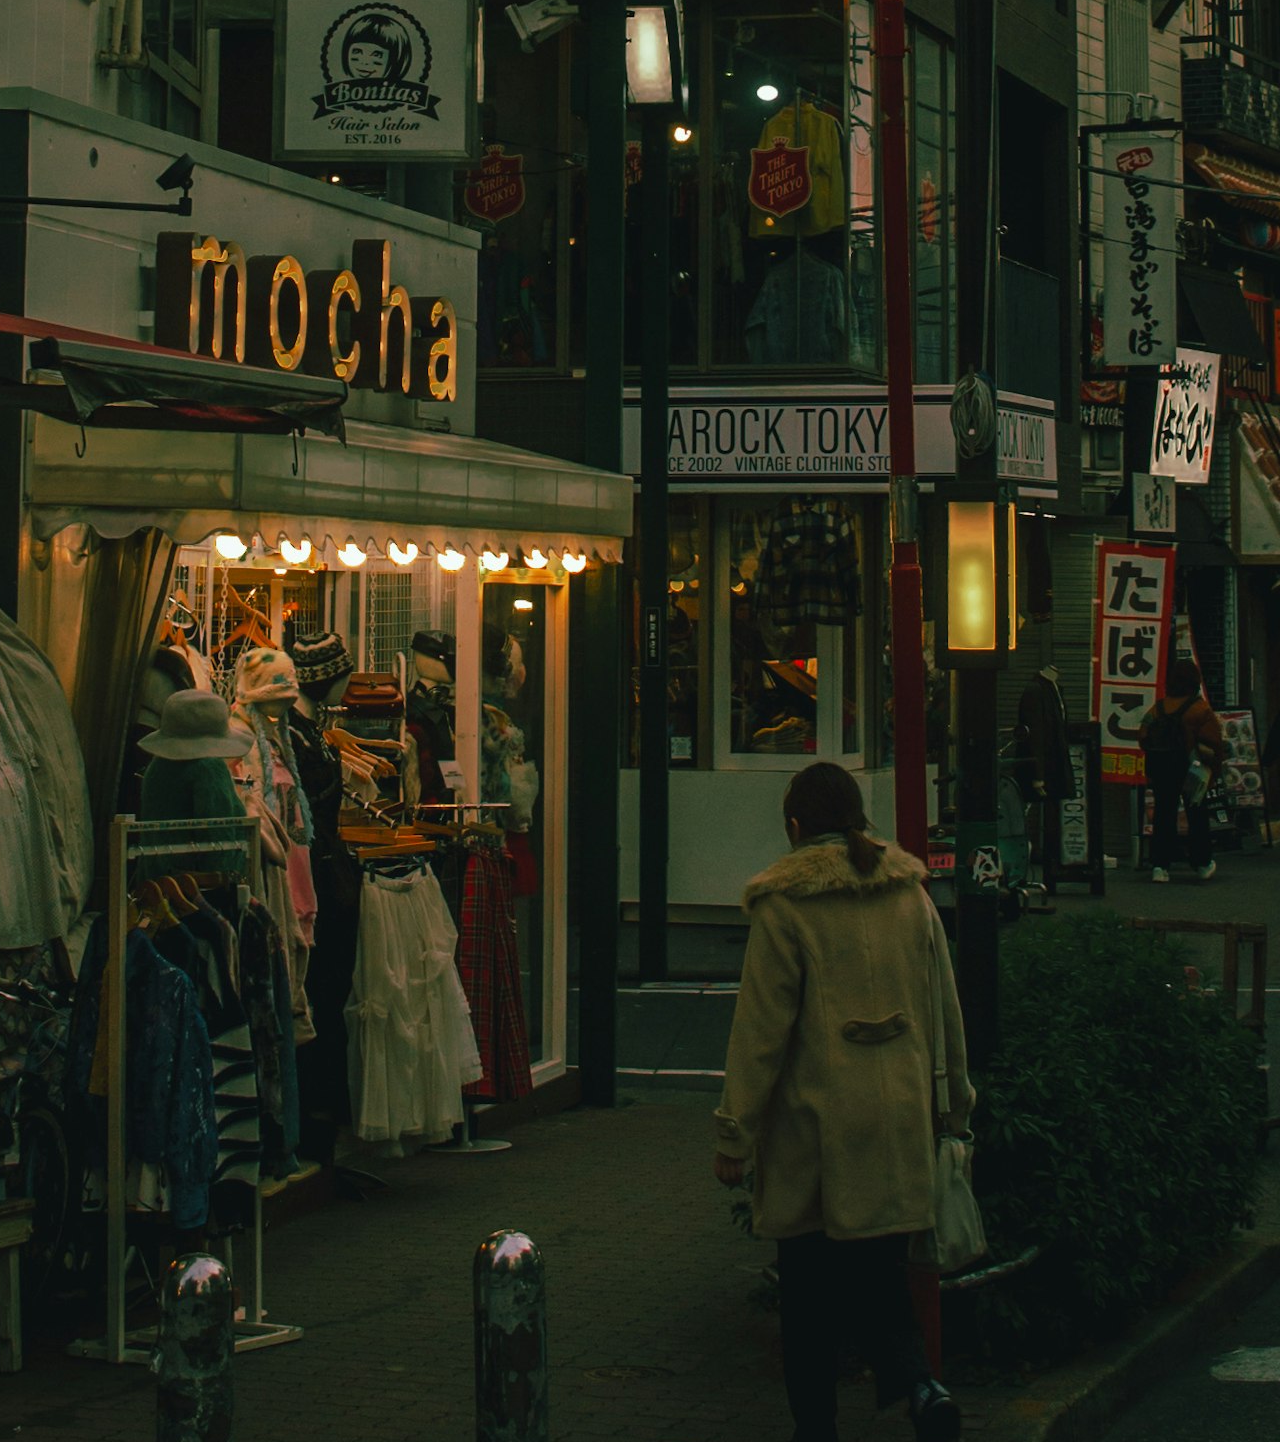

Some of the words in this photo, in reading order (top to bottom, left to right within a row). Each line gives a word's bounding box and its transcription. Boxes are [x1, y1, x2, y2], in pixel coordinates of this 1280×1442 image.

[331, 80, 421, 105] Bonitas
[328, 117, 370, 132] Hair
[374, 116, 421, 132] Salon
[344, 134, 402, 145] EST.2016
[758, 162, 797, 191] THRIFT
[767, 153, 787, 172] THE
[481, 182, 517, 212] TOKYO
[767, 175, 804, 206] TOKYO
[1124, 172, 1161, 357] 台湾まぜそば
[188, 234, 459, 403] mocha
[688, 457, 723, 473] 2002
[734, 456, 793, 472] VINTAGE
[796, 456, 864, 472] CLOTHING
[1107, 560, 1158, 742] たばこ
